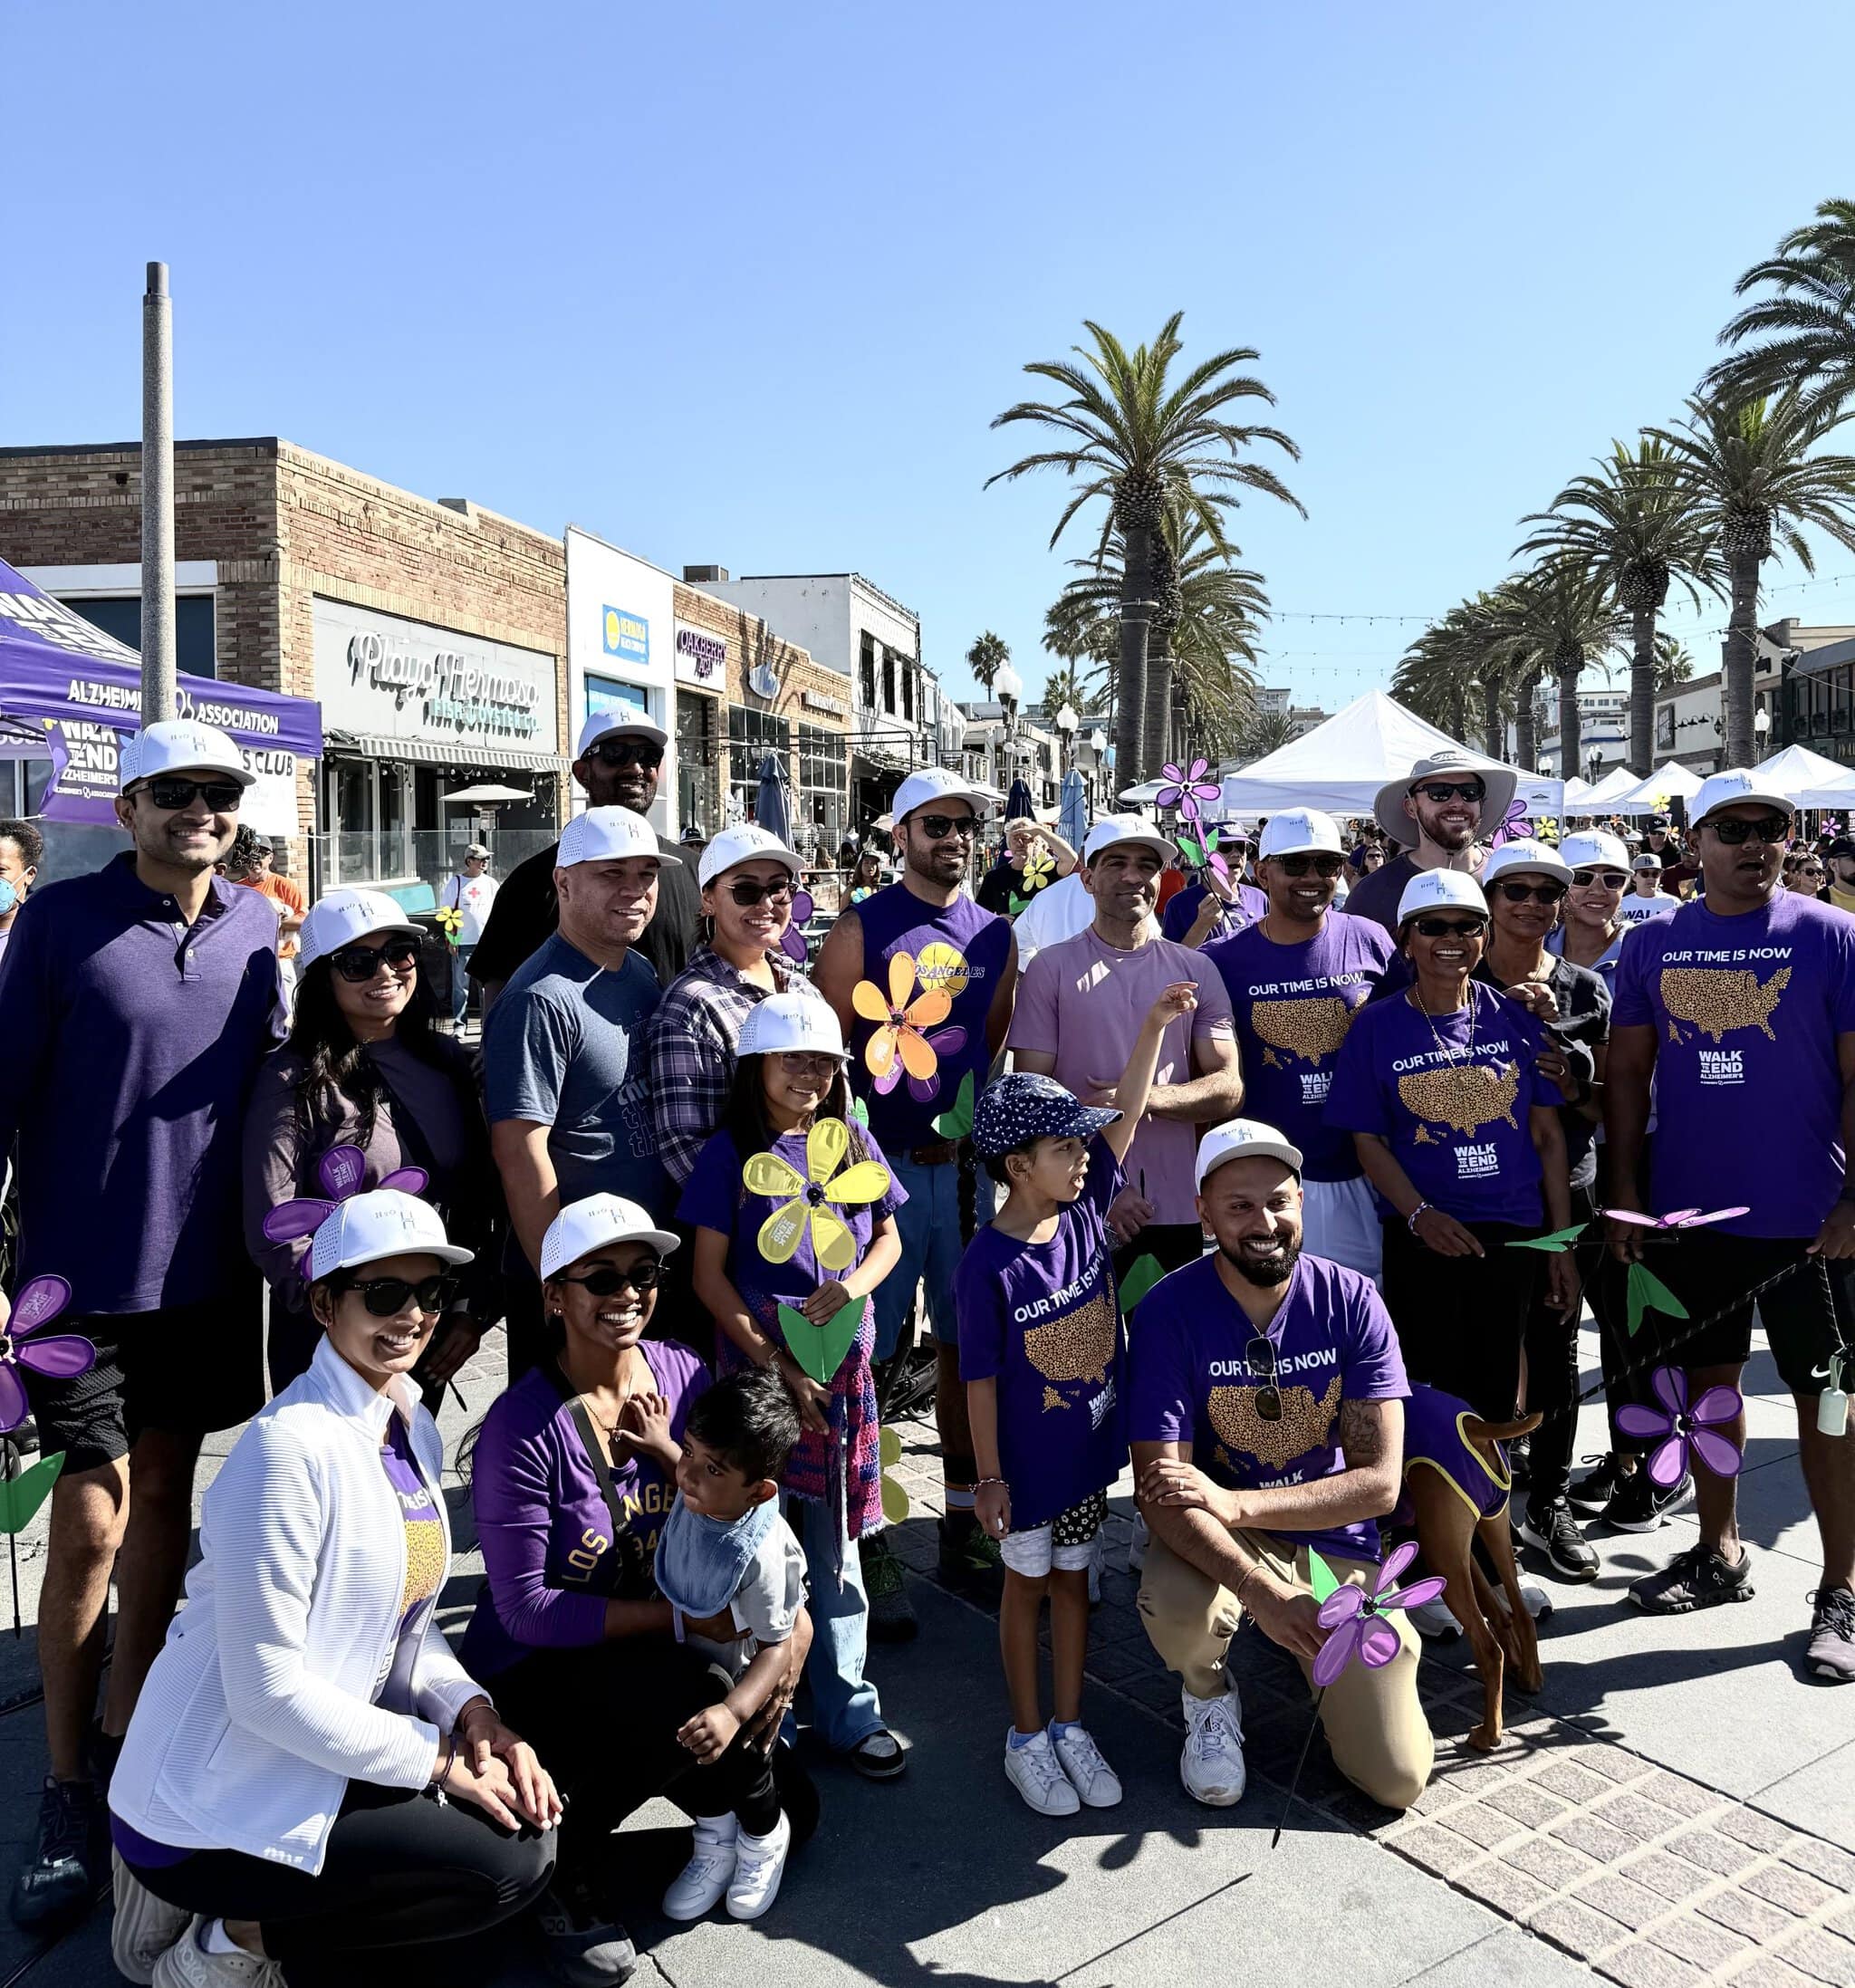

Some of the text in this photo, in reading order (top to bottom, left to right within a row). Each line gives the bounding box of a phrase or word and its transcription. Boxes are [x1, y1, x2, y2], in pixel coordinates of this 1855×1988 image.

[351, 631, 544, 708] Playa Hermosa
[68, 680, 280, 735] ALZHEIM ASSOCIATION
[60, 720, 117, 744] WALK
[255, 751, 293, 777] CLUB
[1622, 908, 1661, 920] WAL
[1662, 947, 1793, 963] OUR TIME IS NOW
[926, 965, 985, 978] ANGELES
[1248, 971, 1364, 996] OUR TIME IS NOW
[1392, 1054, 1426, 1072] OUR
[1424, 1048, 1462, 1063] TIME
[1475, 1040, 1510, 1056] NOW
[1698, 1050, 1744, 1062] WALK
[1711, 1061, 1744, 1074] END
[1313, 1082, 1331, 1094] EN
[1453, 1142, 1496, 1157] WALK
[1468, 1154, 1497, 1167] END
[1014, 1298, 1052, 1323] OUR
[1049, 1280, 1084, 1309] TIME
[1080, 1270, 1094, 1290] IS
[1209, 1360, 1243, 1377] OUR
[1278, 1358, 1293, 1375] IS
[1293, 1347, 1337, 1371] NOW
[1259, 1468, 1304, 1488] WALK
[562, 1527, 609, 1582] LOS
